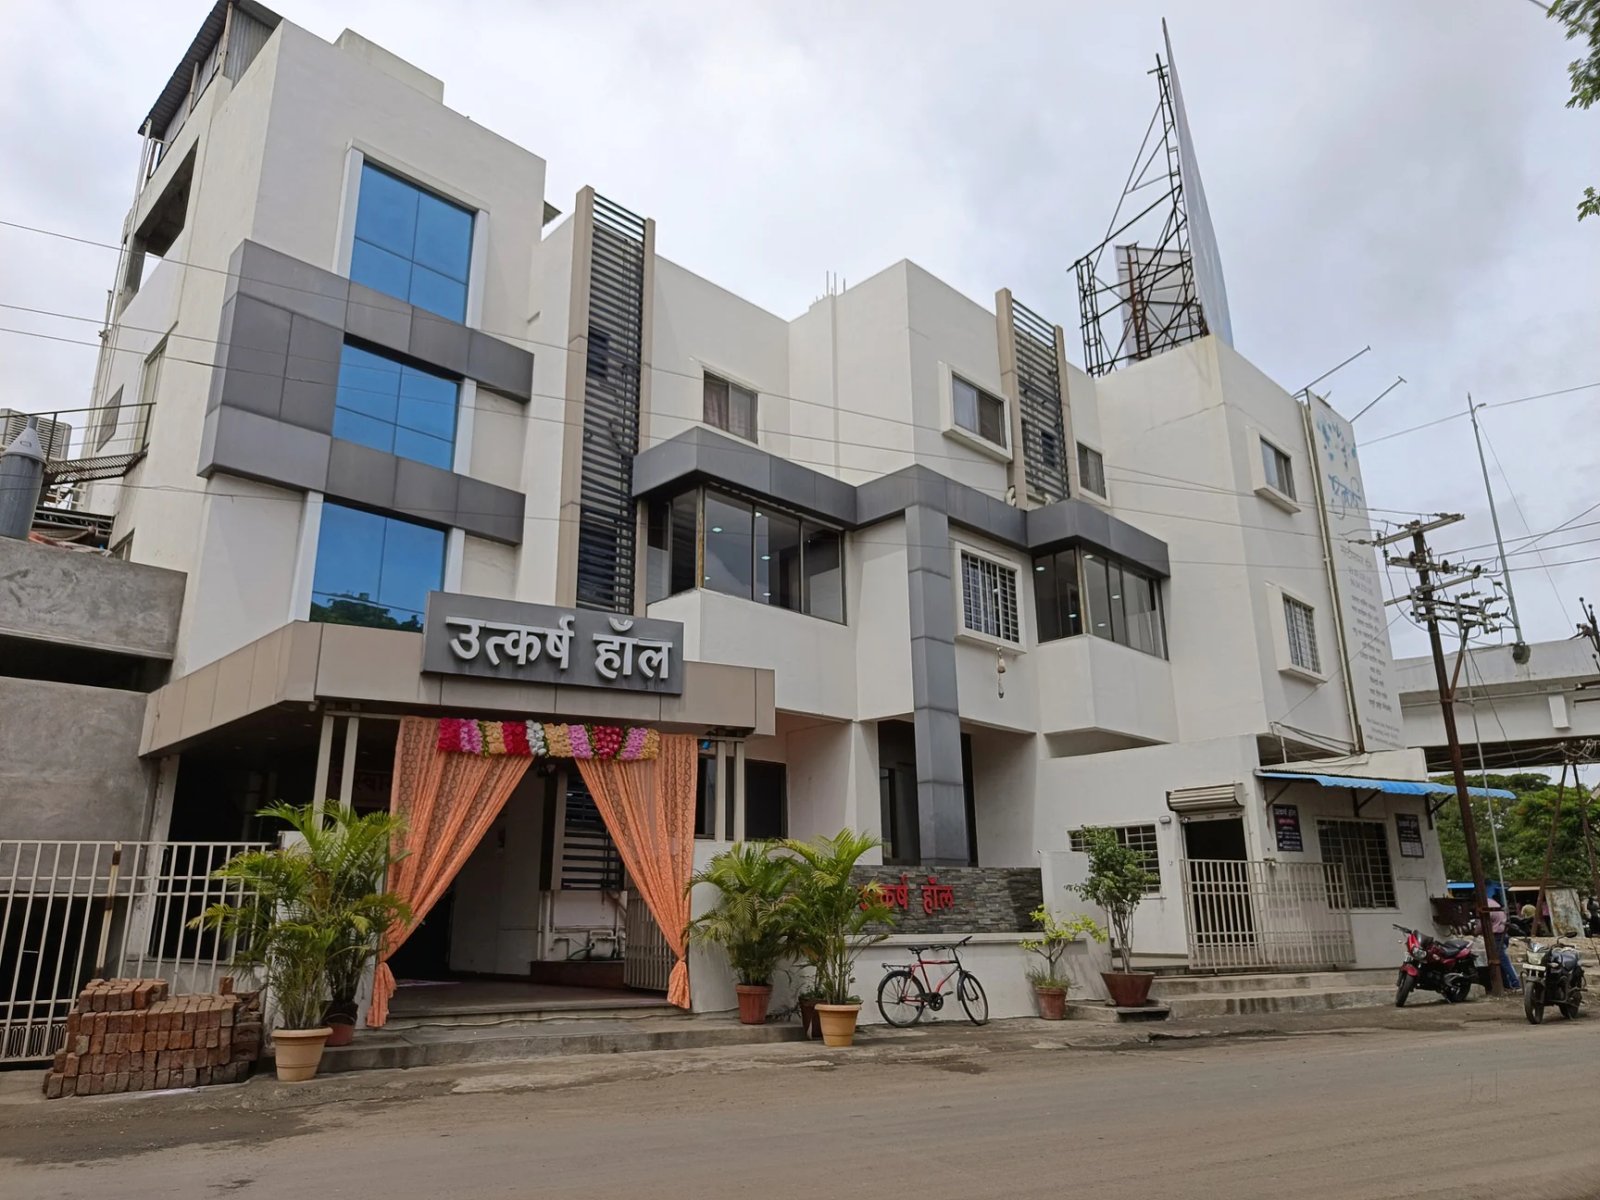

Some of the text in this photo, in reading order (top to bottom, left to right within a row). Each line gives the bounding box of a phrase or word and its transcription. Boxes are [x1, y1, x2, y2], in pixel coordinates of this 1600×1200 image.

[445, 614, 674, 680] उत्कर्ष हॉल
[920, 876, 955, 915] हॉल
